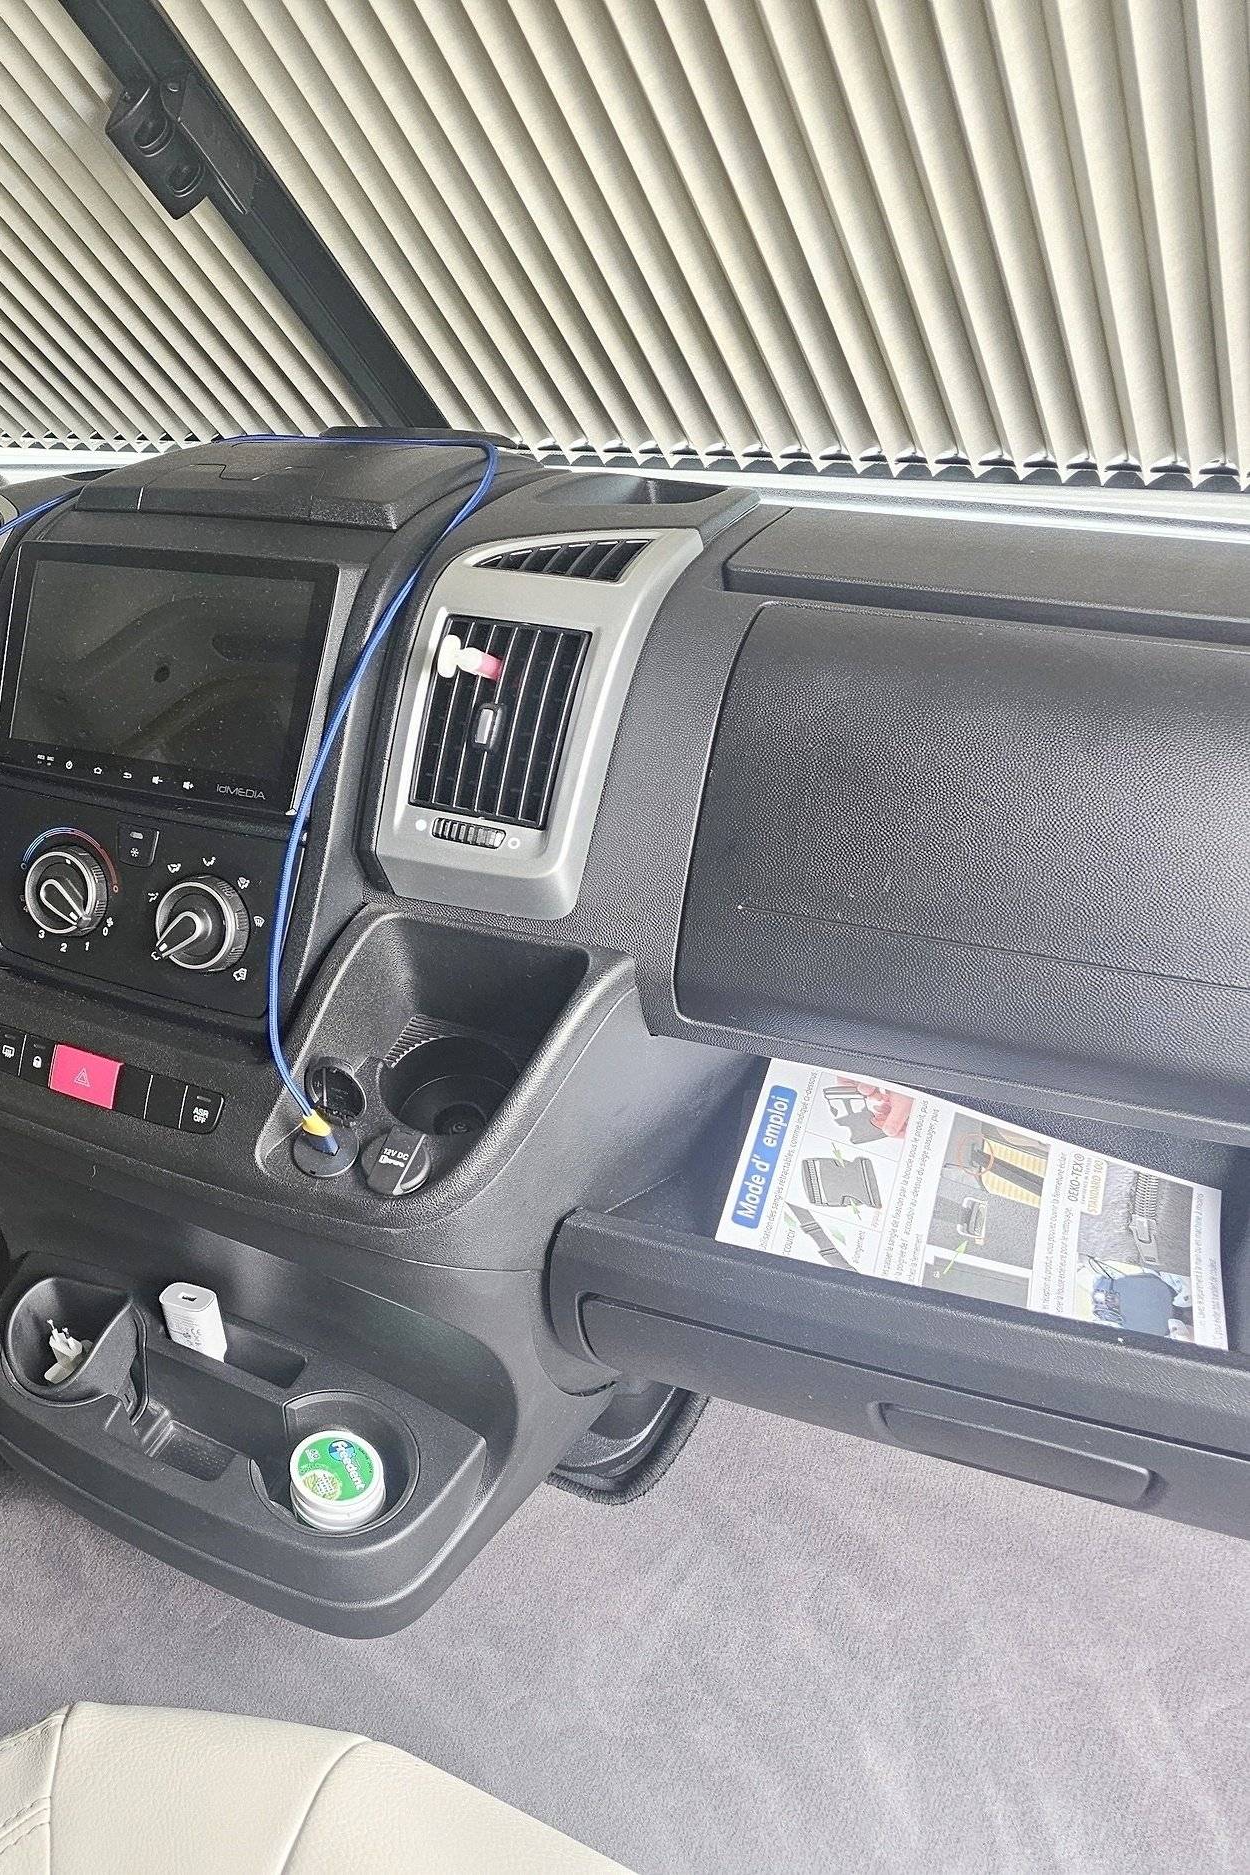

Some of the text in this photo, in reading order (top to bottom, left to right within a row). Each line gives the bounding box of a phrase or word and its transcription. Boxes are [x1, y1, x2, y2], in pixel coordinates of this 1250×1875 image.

[38, 929, 46, 939] 3
[102, 926, 109, 937] 0
[59, 942, 68, 953] 2
[85, 941, 90, 951] 1
[192, 1106, 209, 1119] ASR
[193, 1114, 207, 1124] OFF
[383, 1147, 410, 1161] 12V DC
[736, 1173, 764, 1218] Mode
[762, 1095, 791, 1147] emploi
[902, 1157, 913, 1179] boucle
[1087, 1159, 1103, 1214] STANDARD 100
